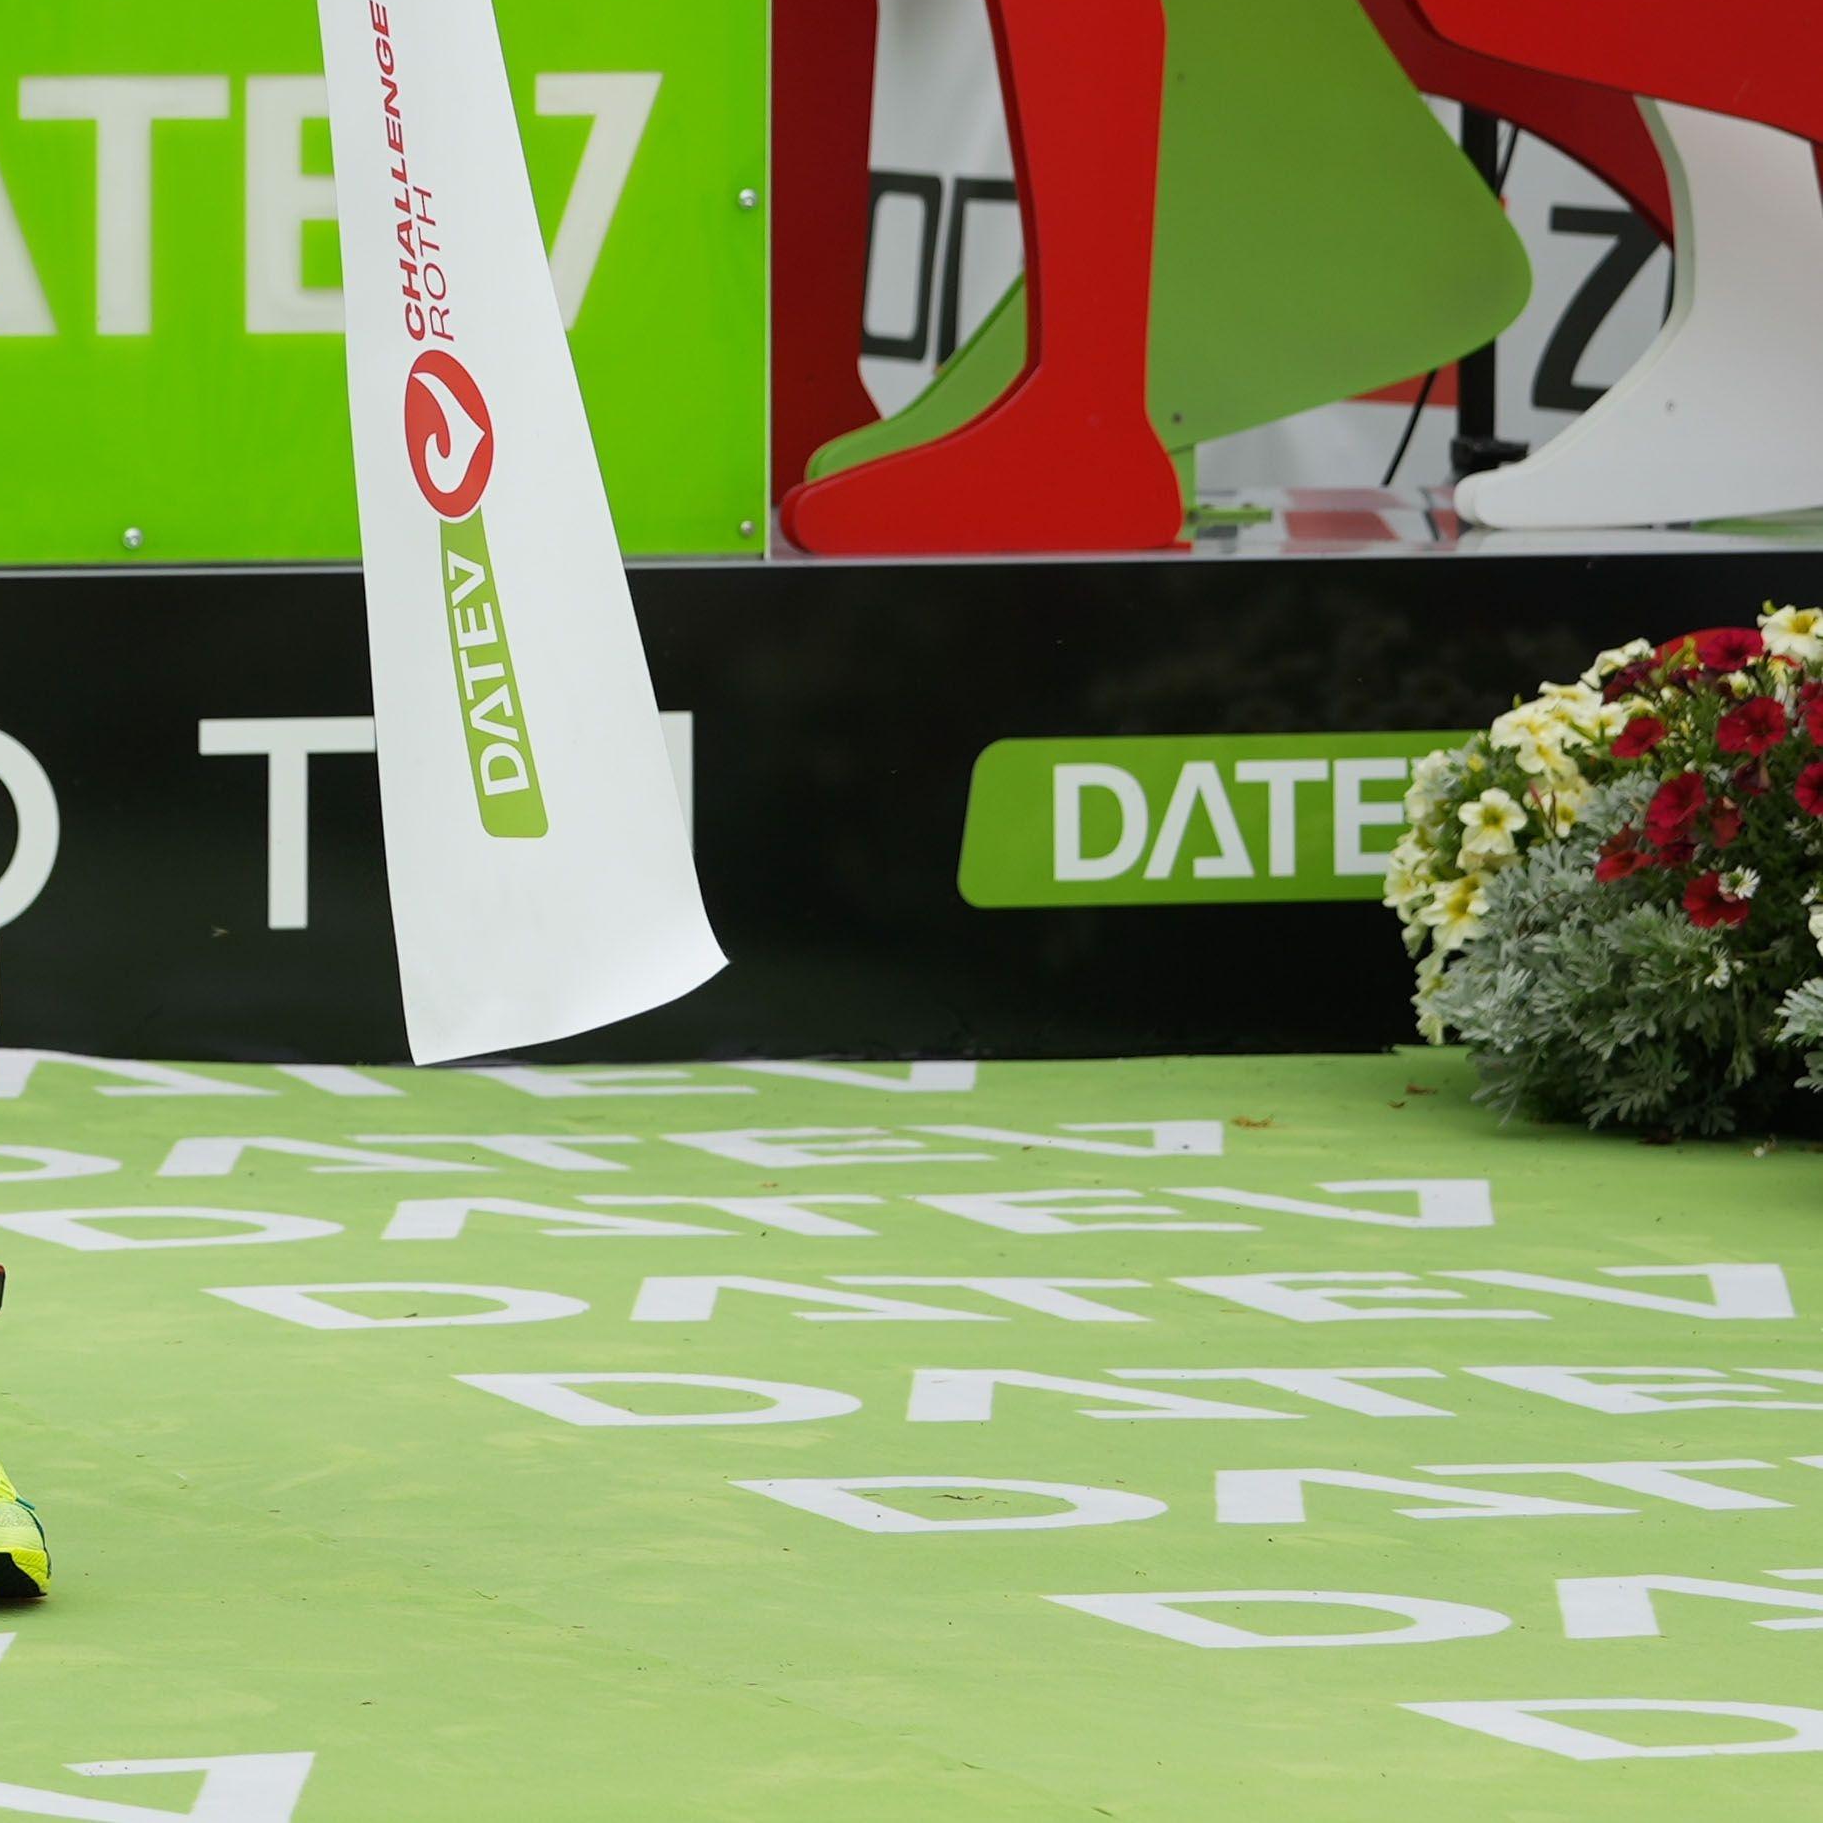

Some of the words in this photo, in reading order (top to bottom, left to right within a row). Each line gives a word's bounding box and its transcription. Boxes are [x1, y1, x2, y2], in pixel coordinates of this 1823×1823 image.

[409, 185, 456, 343] ROTH
[452, 562, 531, 796] DATEV
[1053, 756, 1427, 881] DATE
[205, 1263, 1795, 1332] DATEV
[450, 1365, 1823, 1427] DATE
